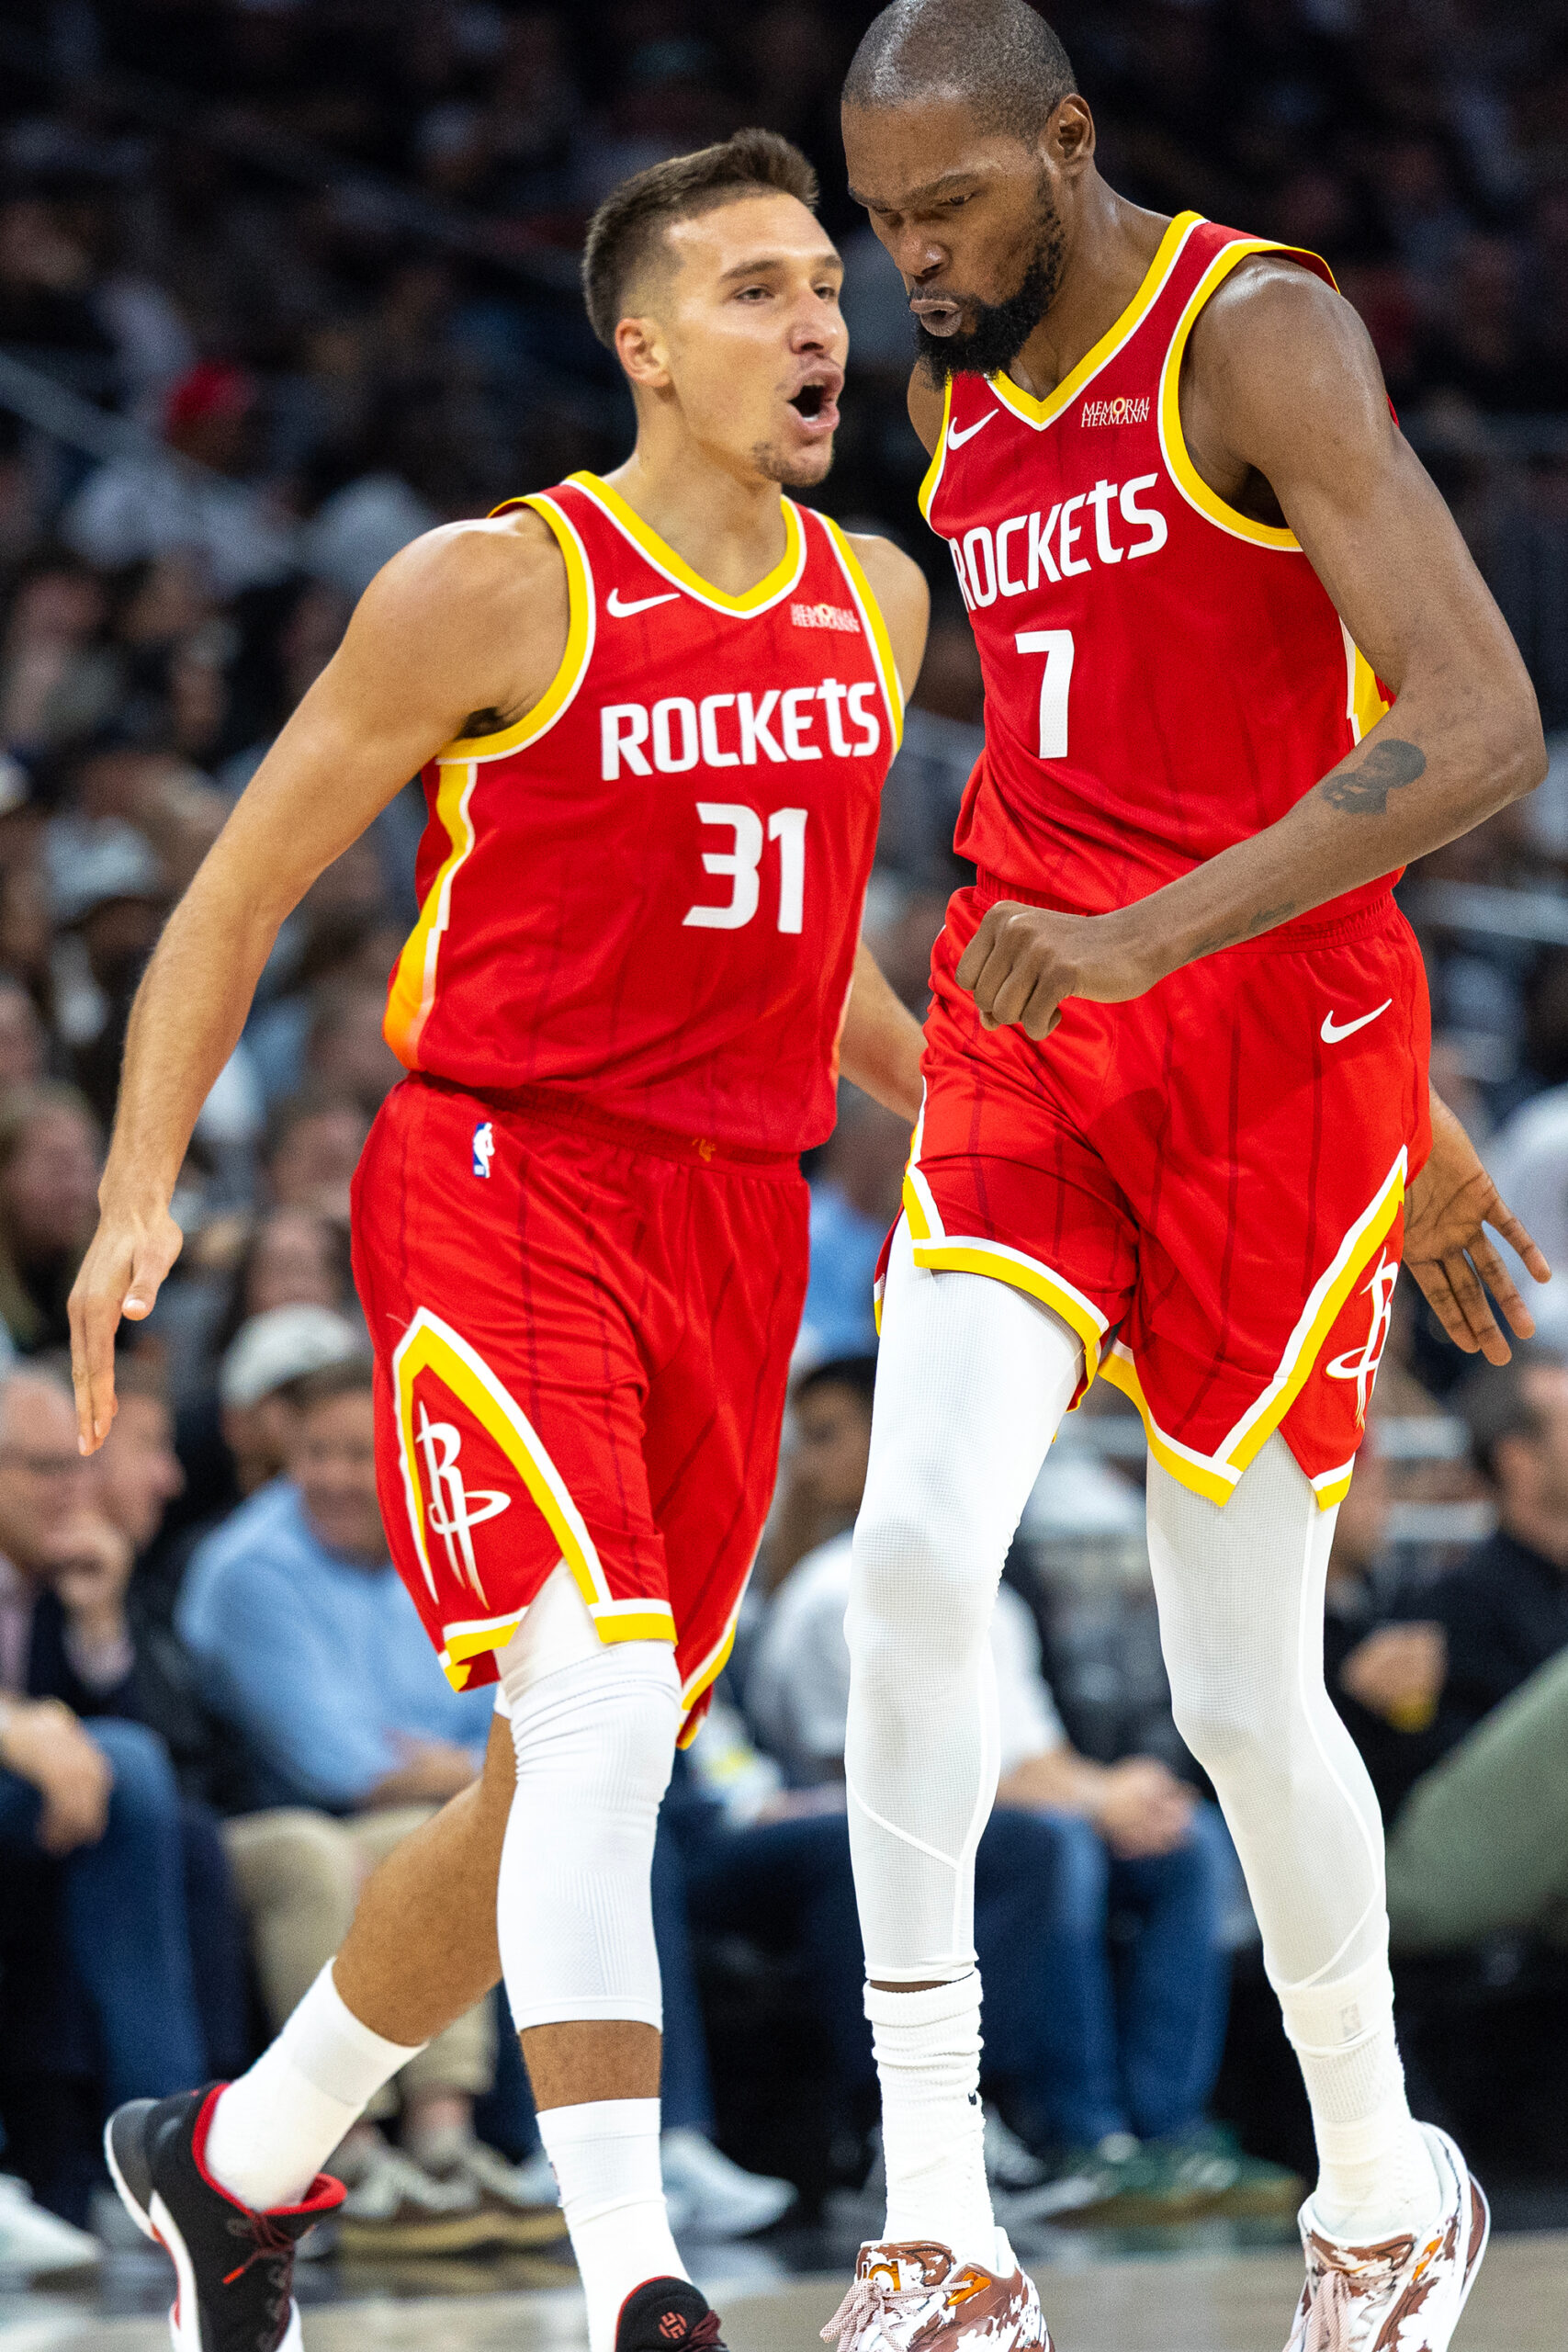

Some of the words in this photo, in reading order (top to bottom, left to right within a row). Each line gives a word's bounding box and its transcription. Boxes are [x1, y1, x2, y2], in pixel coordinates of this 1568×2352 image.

[1081, 409, 1149, 428] HERMANN
[1083, 397, 1151, 415] MEMORIAL
[601, 678, 880, 781] ROCKETS
[1015, 629, 1075, 759] 7
[682, 802, 808, 934] 31
